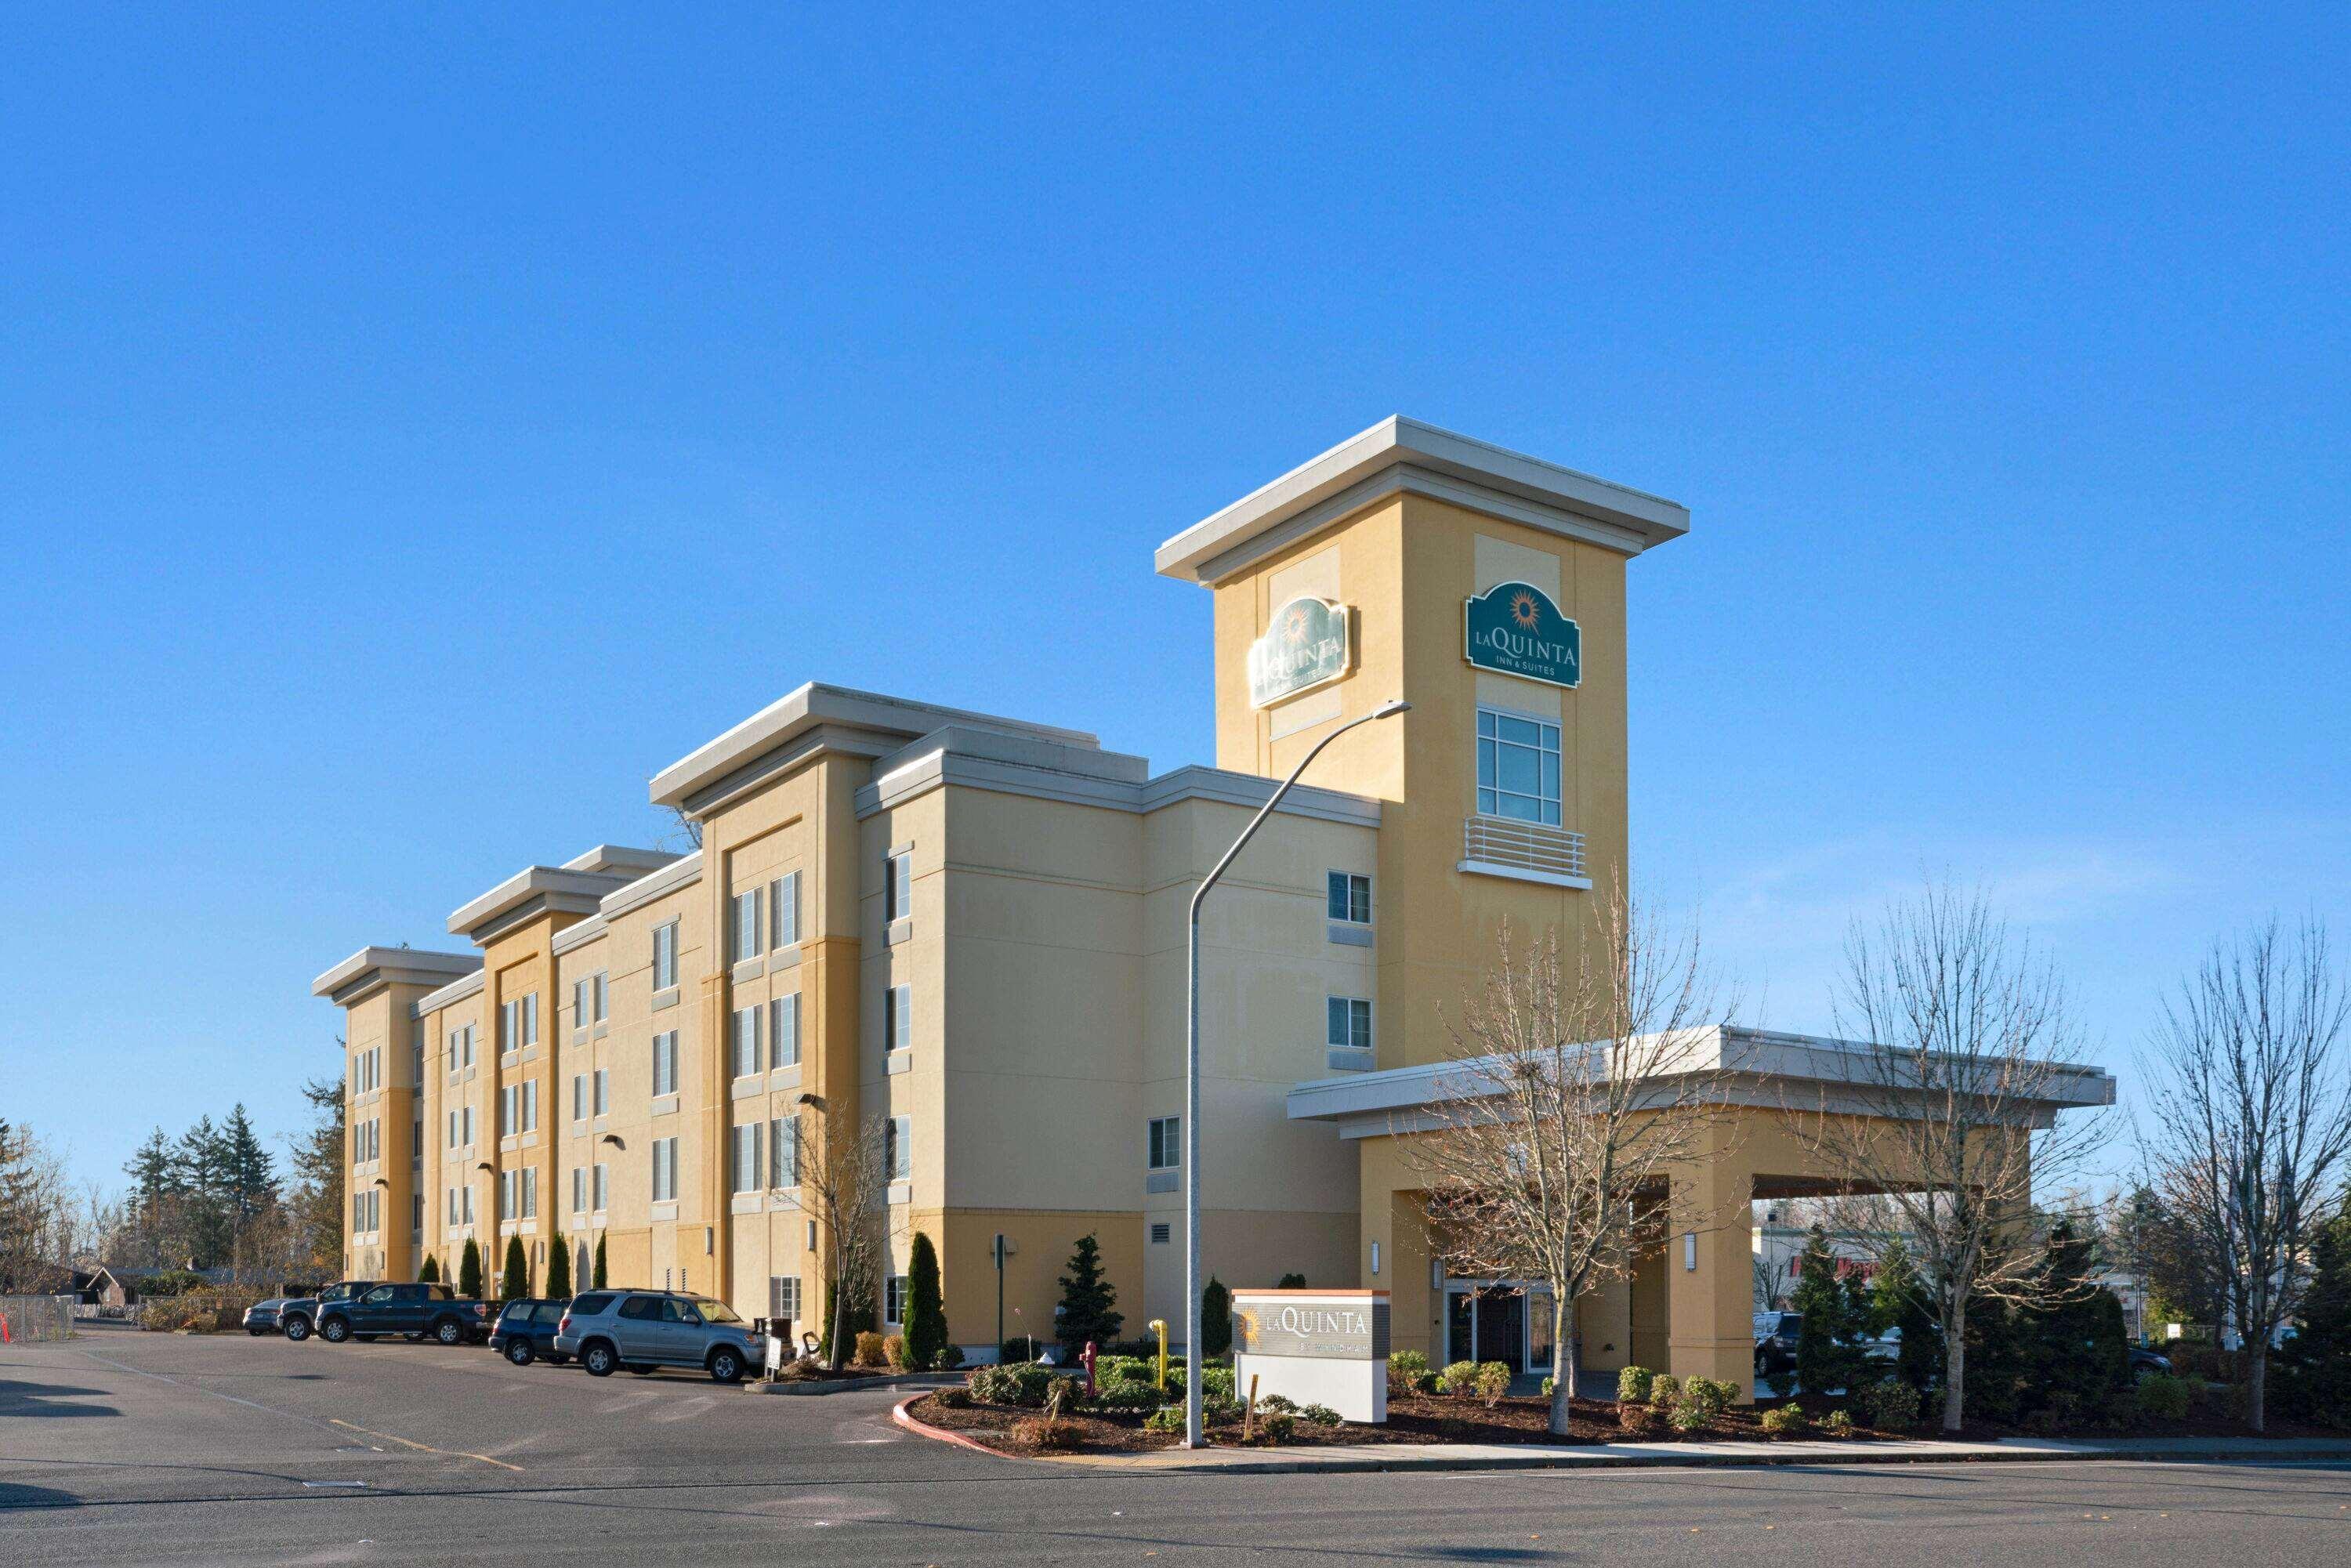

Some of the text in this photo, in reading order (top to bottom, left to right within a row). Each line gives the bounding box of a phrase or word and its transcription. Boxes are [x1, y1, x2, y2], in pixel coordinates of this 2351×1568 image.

[1476, 627, 1577, 666] LA QUINTA
[1496, 655, 1512, 667] INN
[1522, 661, 1556, 676] SUITES
[1266, 1305, 1368, 1338] LA QUINTA
